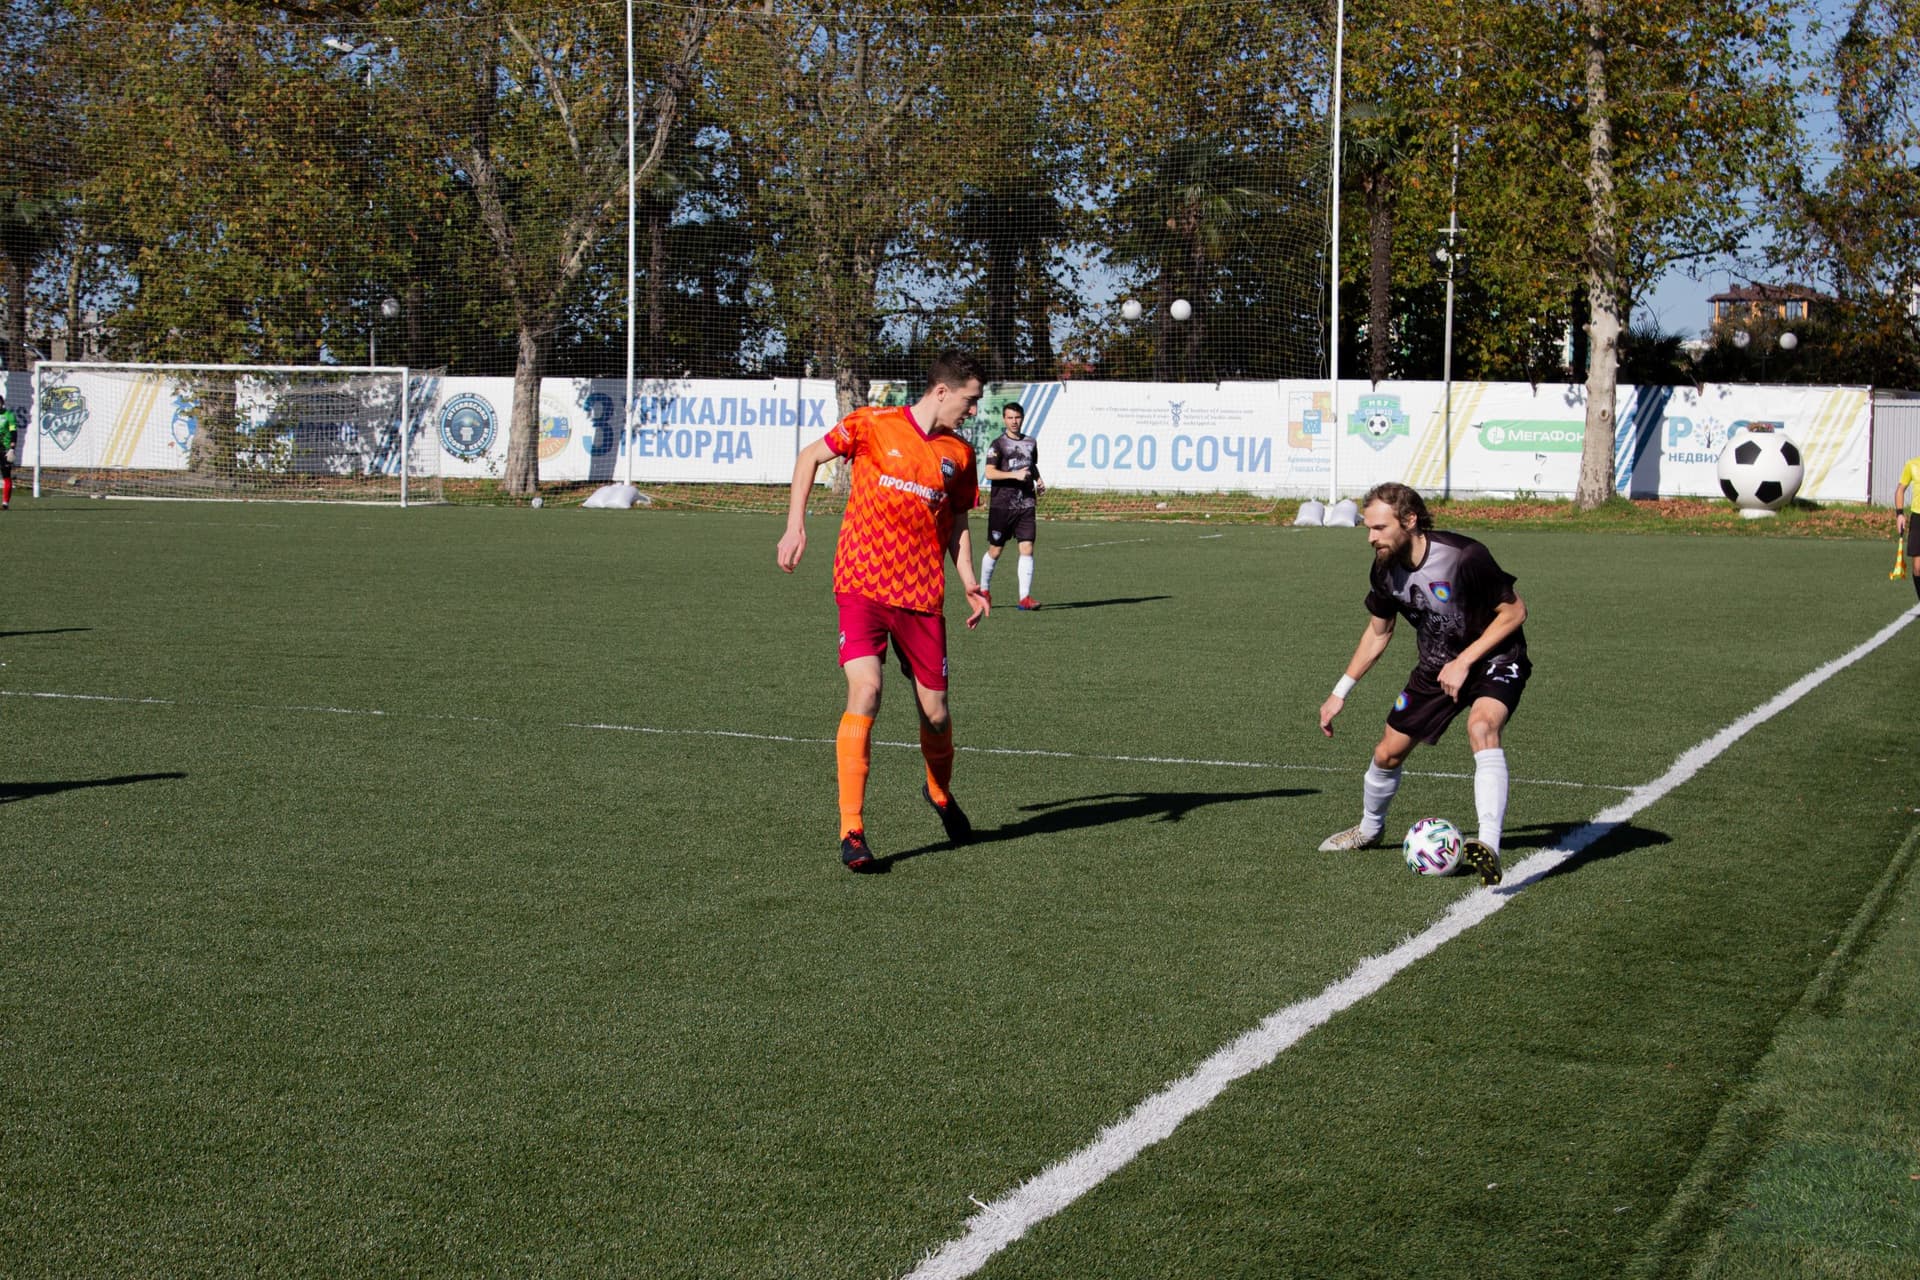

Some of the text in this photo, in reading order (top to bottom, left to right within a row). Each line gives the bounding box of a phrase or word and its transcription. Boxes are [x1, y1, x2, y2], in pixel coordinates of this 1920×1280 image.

[582, 393, 614, 456] 3
[621, 396, 826, 427] УНИКАЛЬНЫХ
[620, 428, 753, 464] РЕКОРДА
[1067, 433, 1272, 472] 2020 СОЧИ
